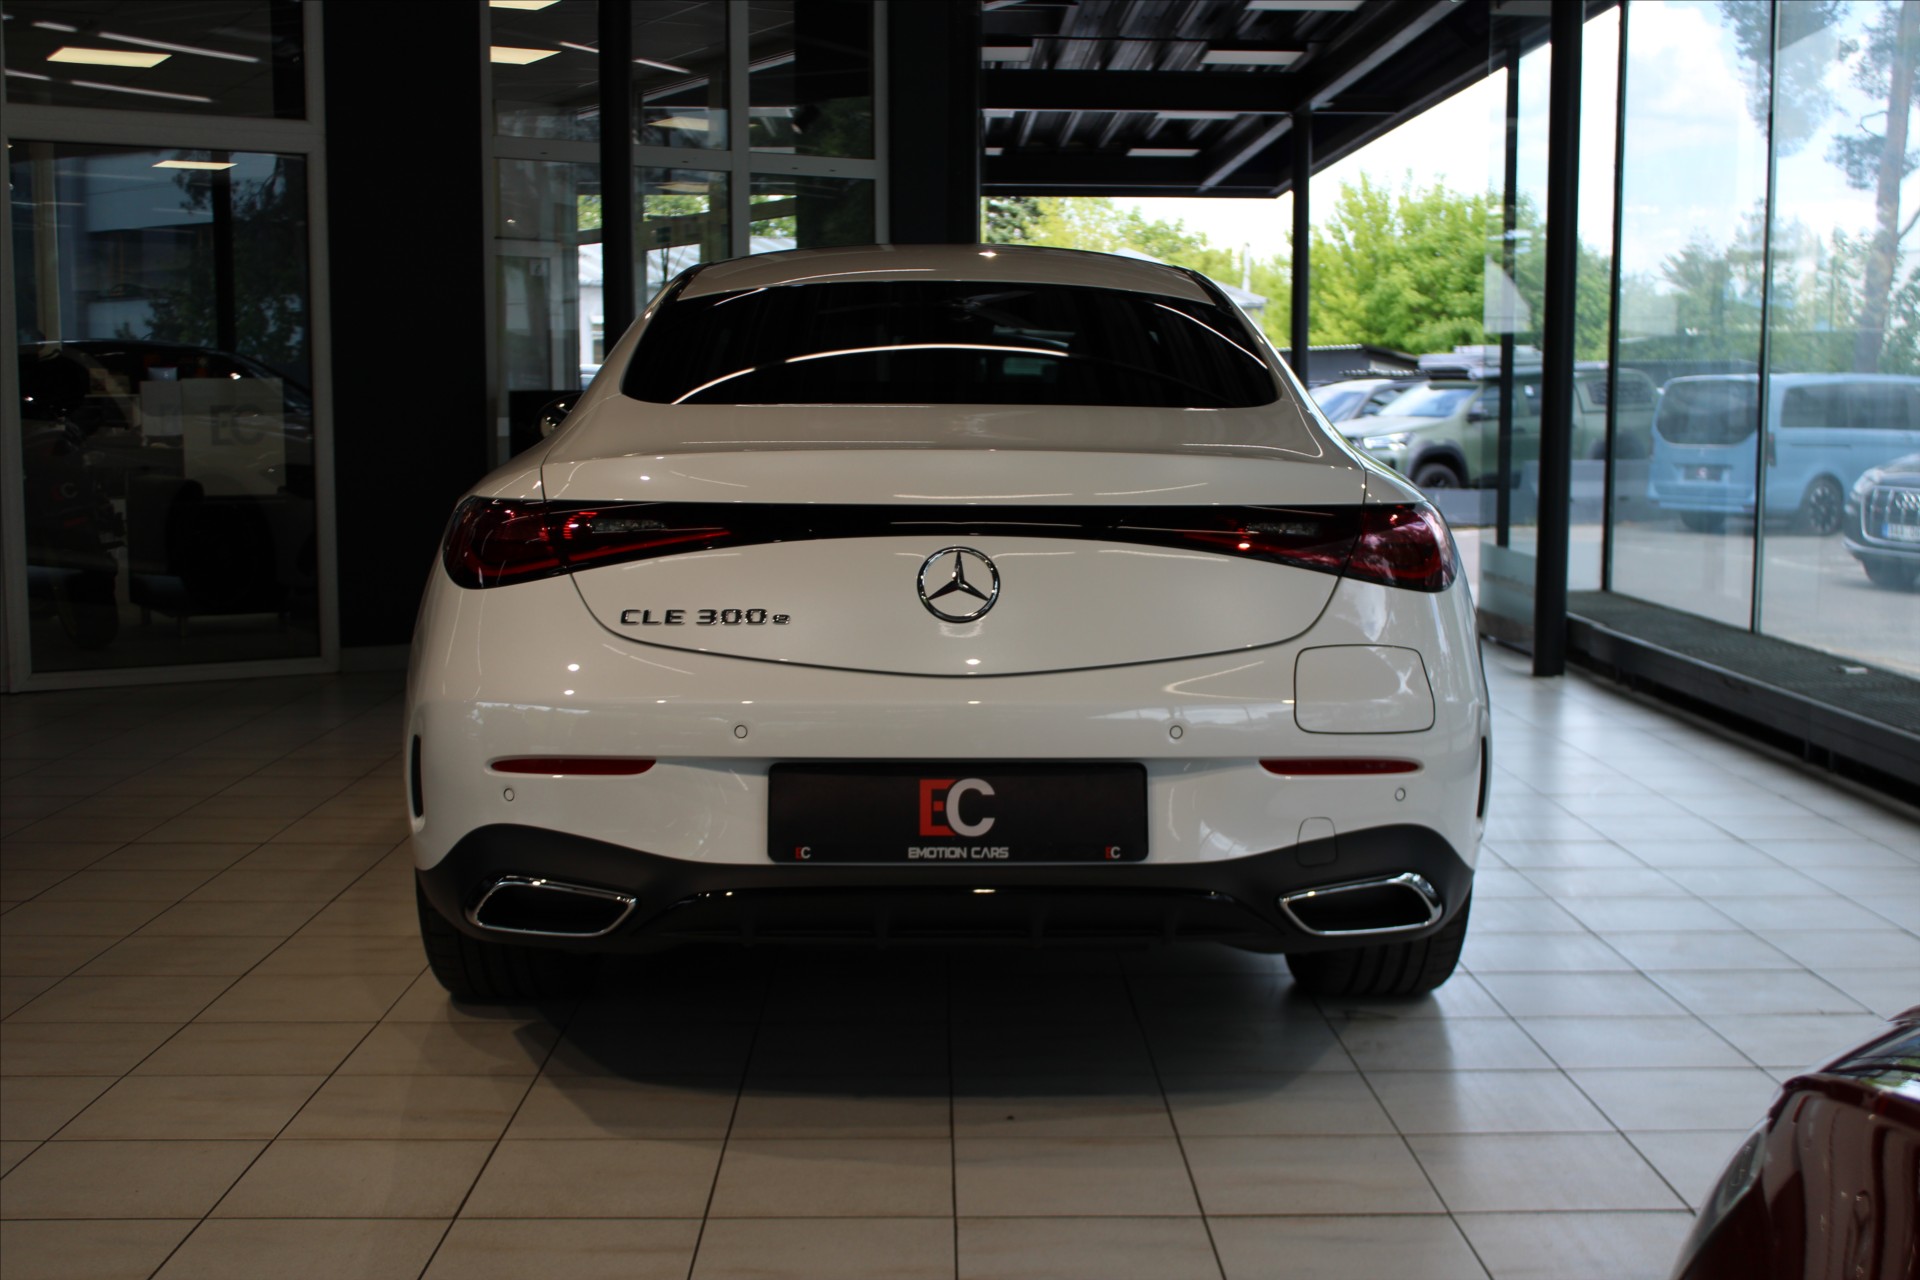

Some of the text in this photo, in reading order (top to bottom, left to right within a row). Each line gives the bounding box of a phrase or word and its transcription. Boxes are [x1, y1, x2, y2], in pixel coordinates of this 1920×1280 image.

[620, 609, 686, 626] CLE
[918, 777, 996, 838] EC
[795, 846, 811, 860] EC
[907, 846, 1010, 860] EMOTION CARS
[1105, 846, 1121, 860] EC
